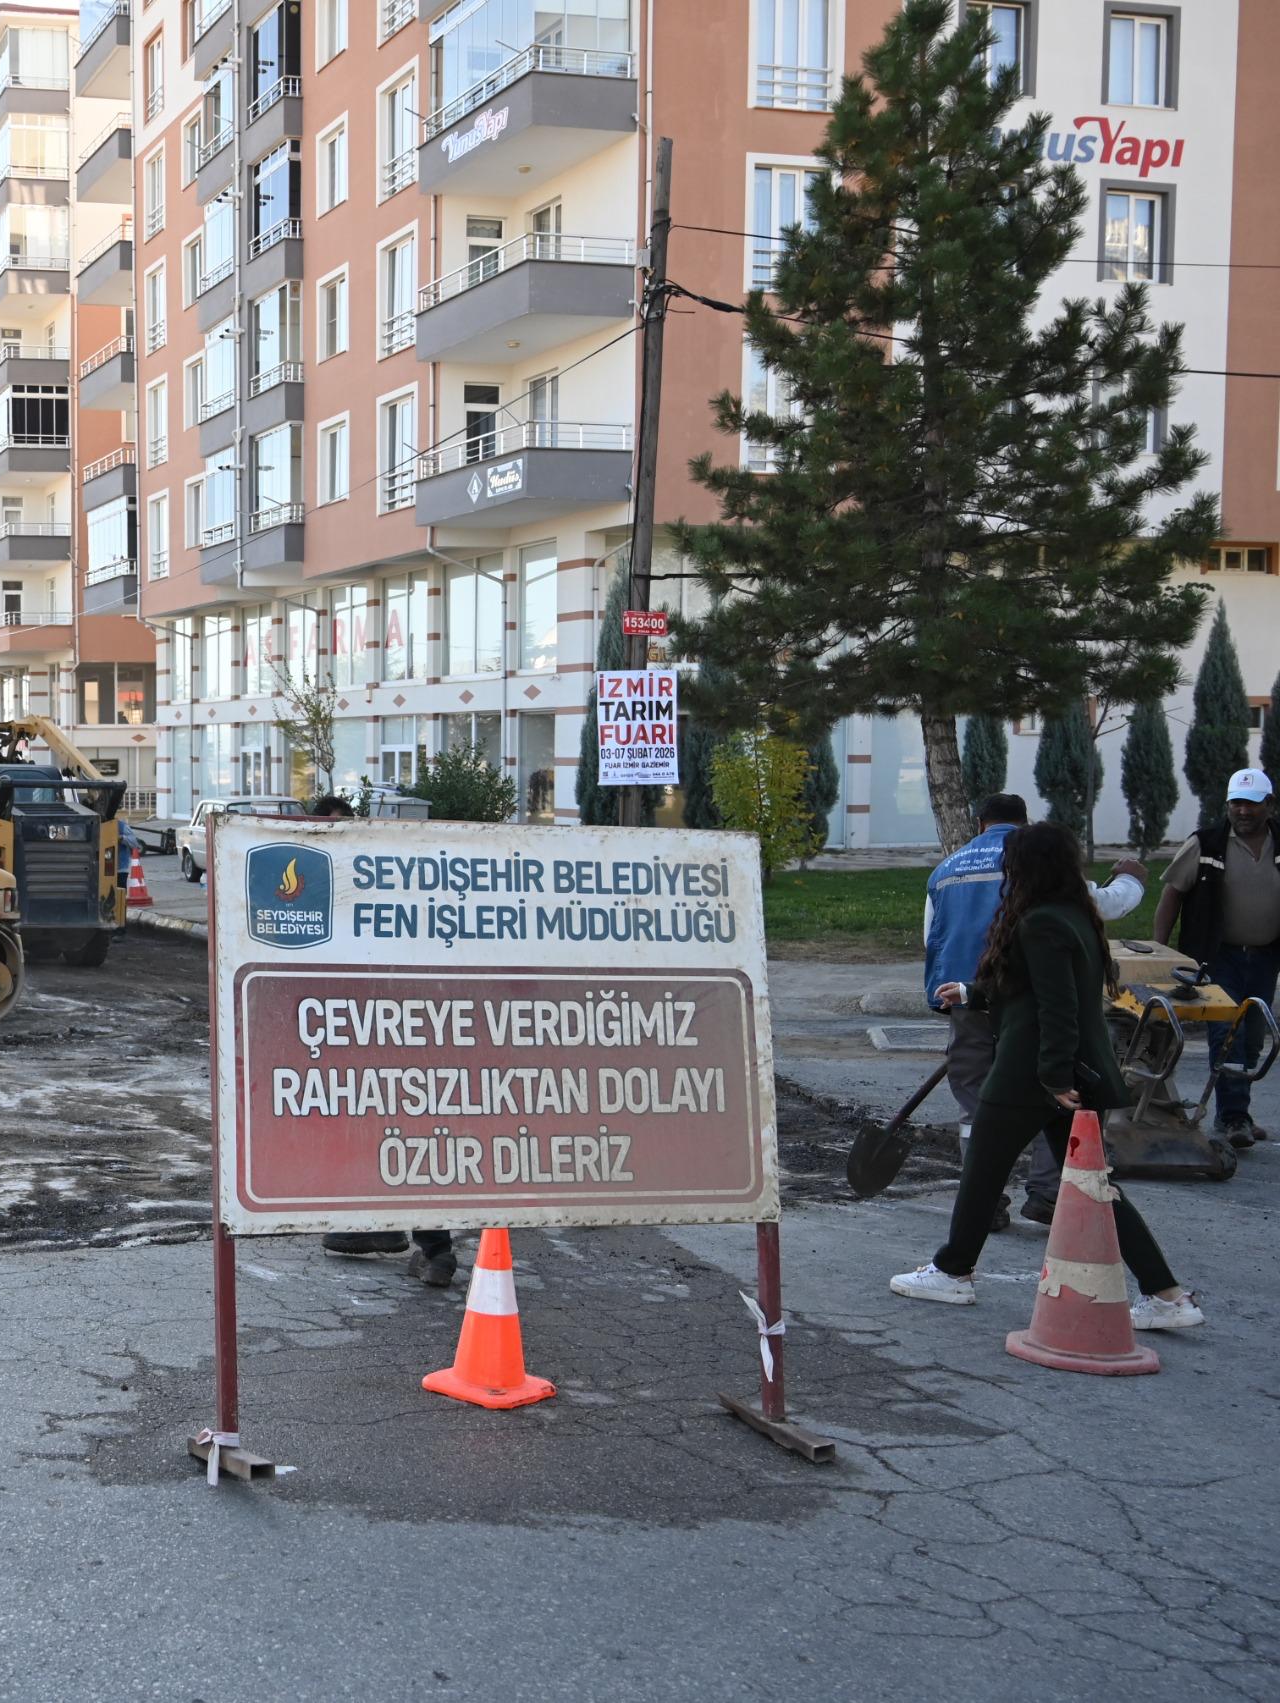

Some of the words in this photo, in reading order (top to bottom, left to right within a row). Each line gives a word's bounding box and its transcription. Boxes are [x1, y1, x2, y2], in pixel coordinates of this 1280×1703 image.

[599, 673, 673, 699] İZMİR
[599, 700, 673, 722] TARIM
[600, 723, 674, 746] FUARI
[601, 748, 625, 759] 03-07
[627, 747, 653, 761] ŞUBAT
[655, 747, 675, 759] 2026
[48, 825, 70, 840] CAT
[353, 850, 543, 899] SEYDİŞEHİR
[554, 855, 730, 898] BELEDİYESİ
[256, 909, 323, 923] SEYDİŞEHİR
[353, 903, 417, 940] FEN
[427, 897, 527, 947] İŞLERİ
[537, 899, 736, 944] MÜDÜRLÜĞÜ
[256, 922, 324, 935] BELEDİYESİ
[298, 998, 475, 1058] ÇEVREYE
[484, 989, 698, 1047] VERDİĞİMİZ
[273, 1067, 589, 1116] RAHATSIZLIKTAN
[599, 1066, 726, 1114] DOLAYI
[380, 1127, 483, 1186] ÖZÜR
[493, 1124, 634, 1183] DİLERİZ
